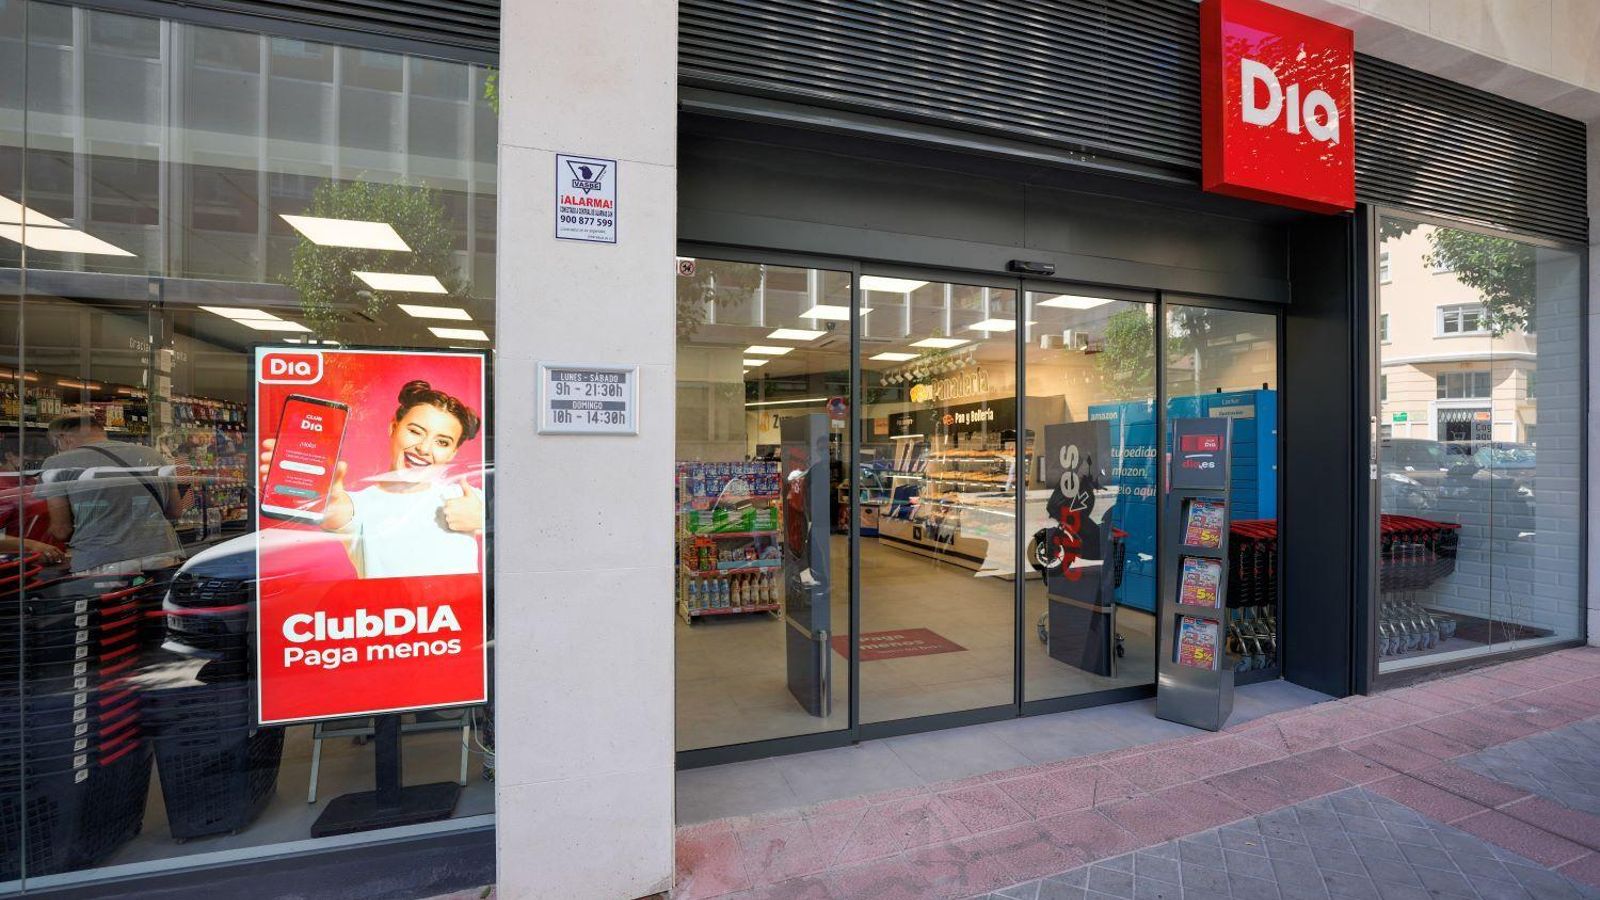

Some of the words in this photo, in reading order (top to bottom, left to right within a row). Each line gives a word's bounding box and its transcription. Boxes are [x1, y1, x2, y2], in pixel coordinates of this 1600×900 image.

[1240, 57, 1340, 145] Dia
[560, 195, 613, 209] ¡ALARMA!
[560, 215, 577, 224] 900
[578, 216, 595, 225] 877
[597, 218, 613, 228] 599
[270, 358, 311, 376] Dia
[560, 373, 582, 382] LUNES
[590, 372, 619, 383] SÁBADO
[556, 382, 571, 396] 9h
[585, 383, 623, 397] 21:30h
[572, 401, 604, 410] DOMINGO
[553, 410, 572, 424] 10h
[587, 411, 625, 425] 14:30h
[955, 412, 965, 424] Pan
[301, 419, 323, 432] Dia
[1196, 588, 1216, 601] 5%
[282, 604, 462, 643] ClubDIA
[284, 646, 358, 670] Paga
[366, 638, 461, 661] menos
